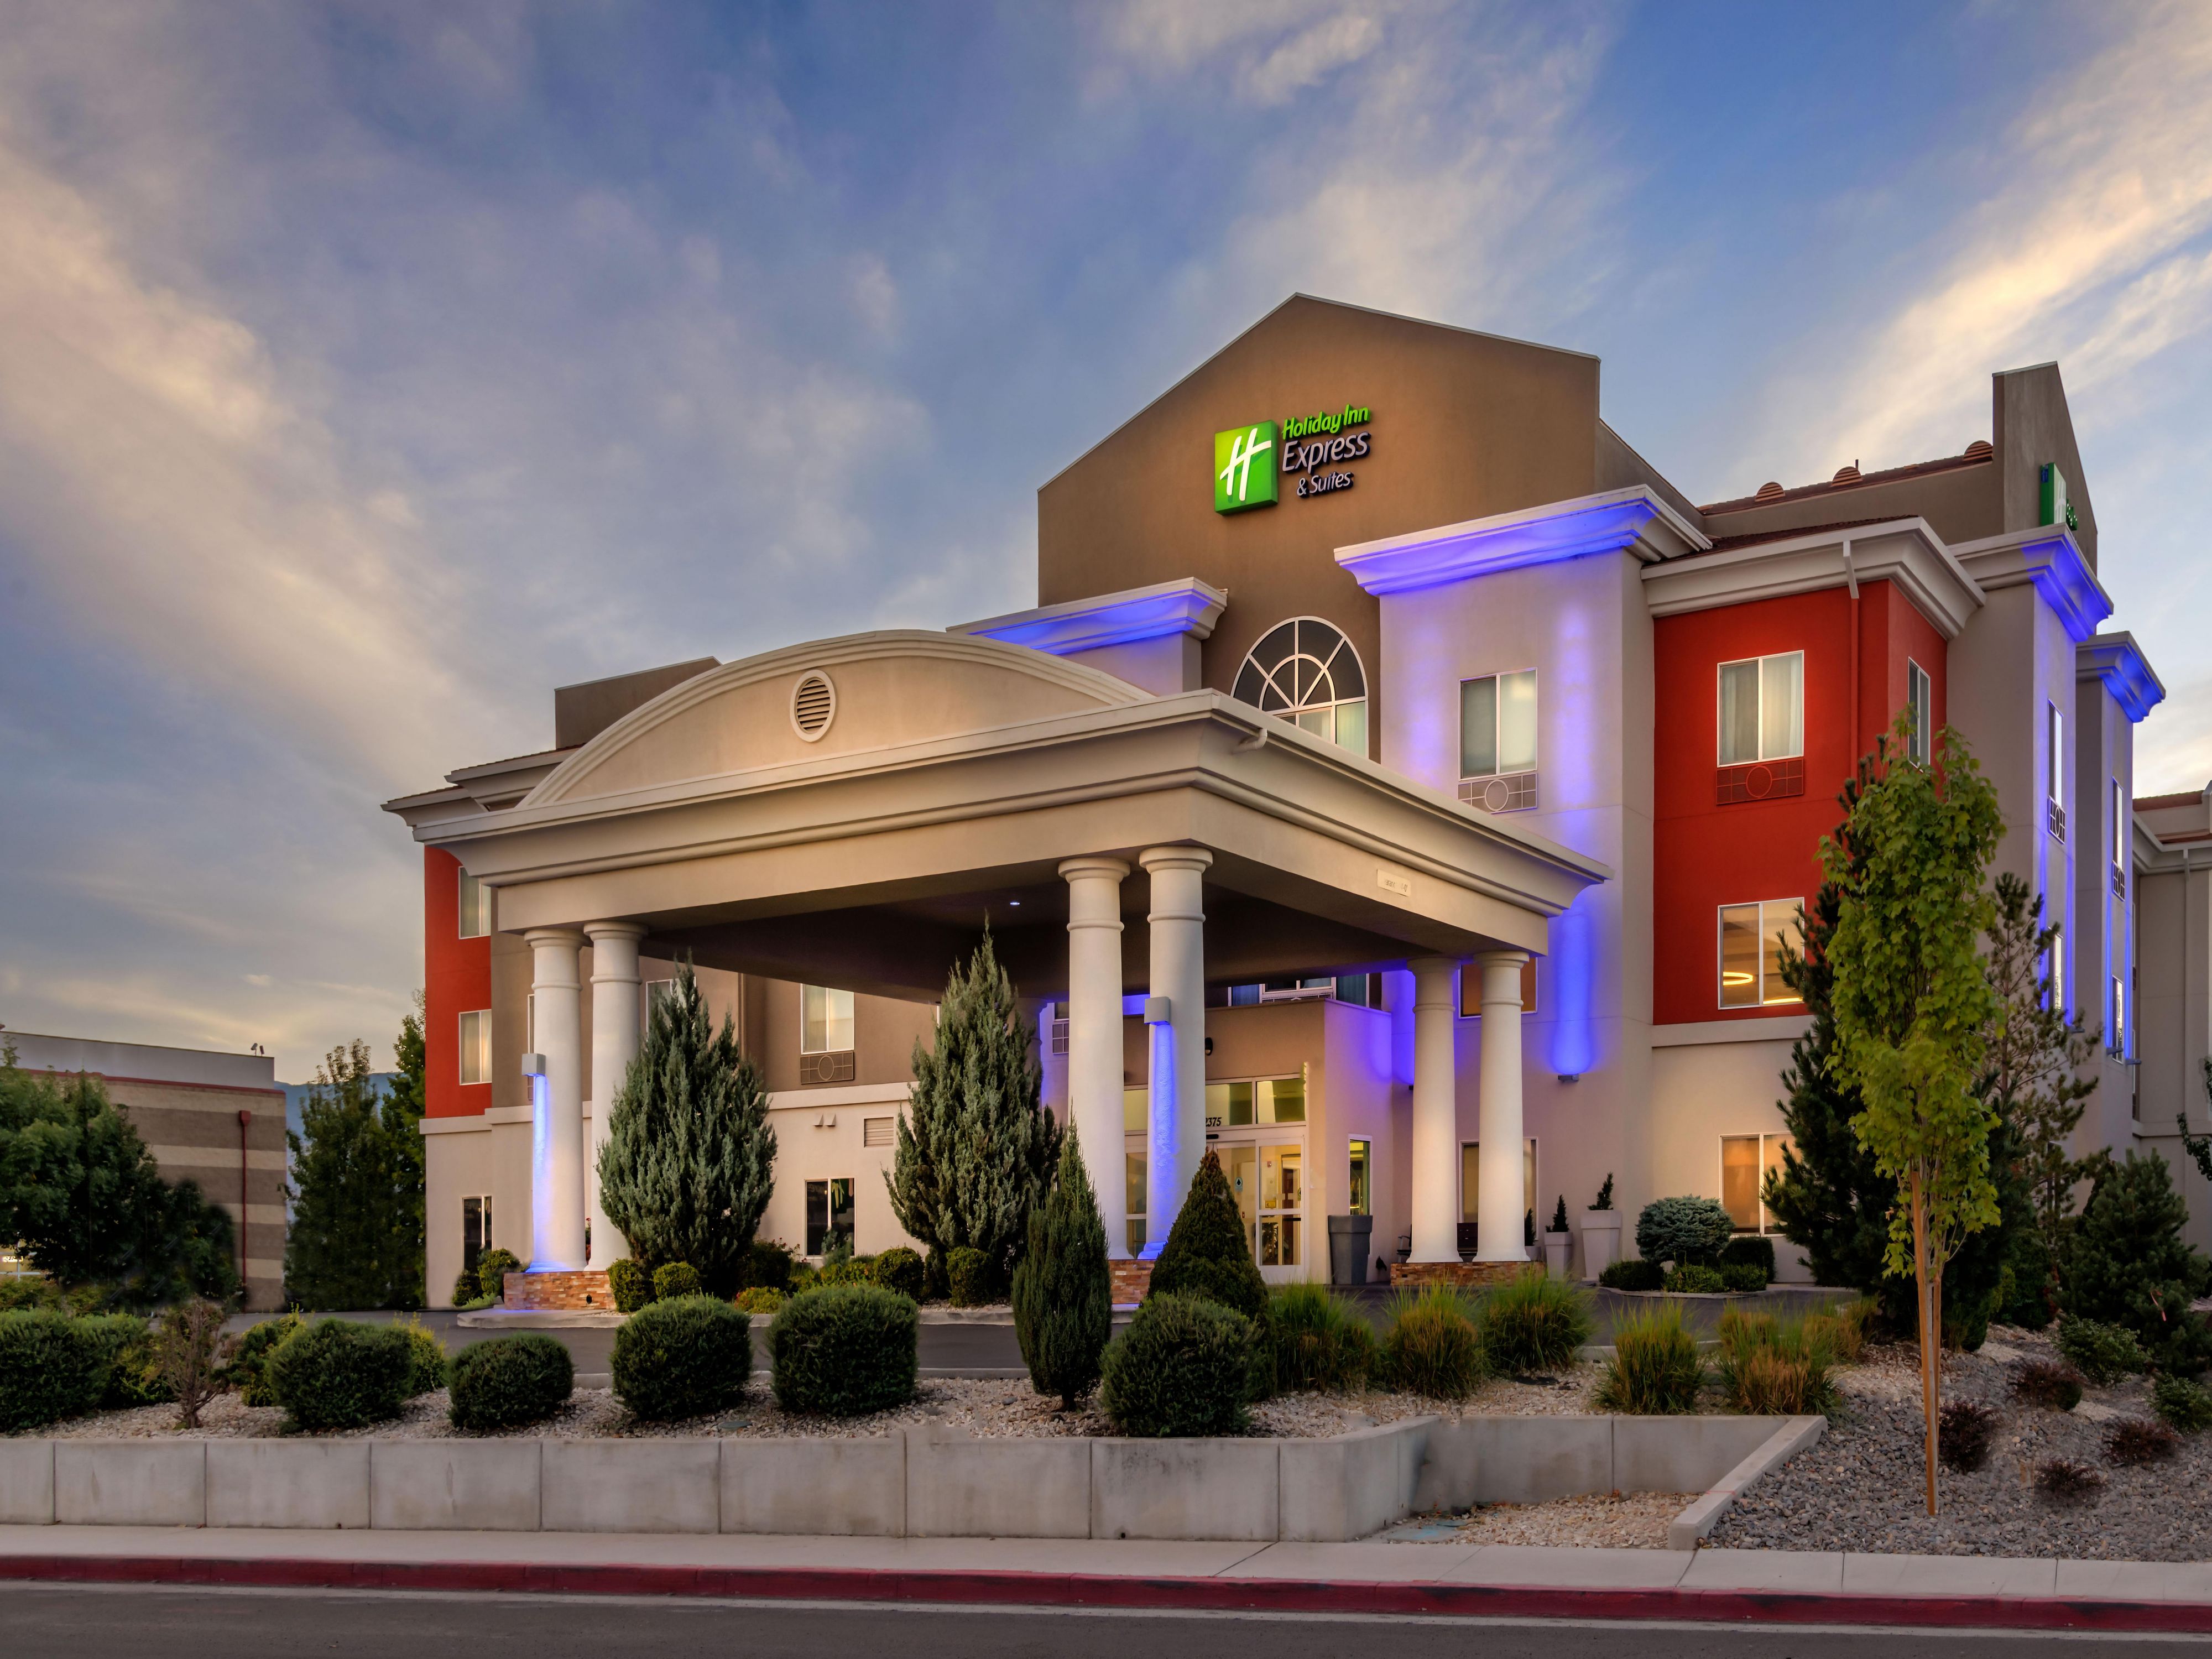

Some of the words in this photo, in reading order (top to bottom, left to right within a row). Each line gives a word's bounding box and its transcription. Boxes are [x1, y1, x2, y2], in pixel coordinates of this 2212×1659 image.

[1282, 411, 1342, 440] Holiday
[1343, 404, 1370, 426] Inn
[1282, 432, 1371, 474] Express
[1296, 478, 1309, 497] &
[1309, 471, 1353, 494] Suites
[1206, 1117, 1222, 1126] 2375
